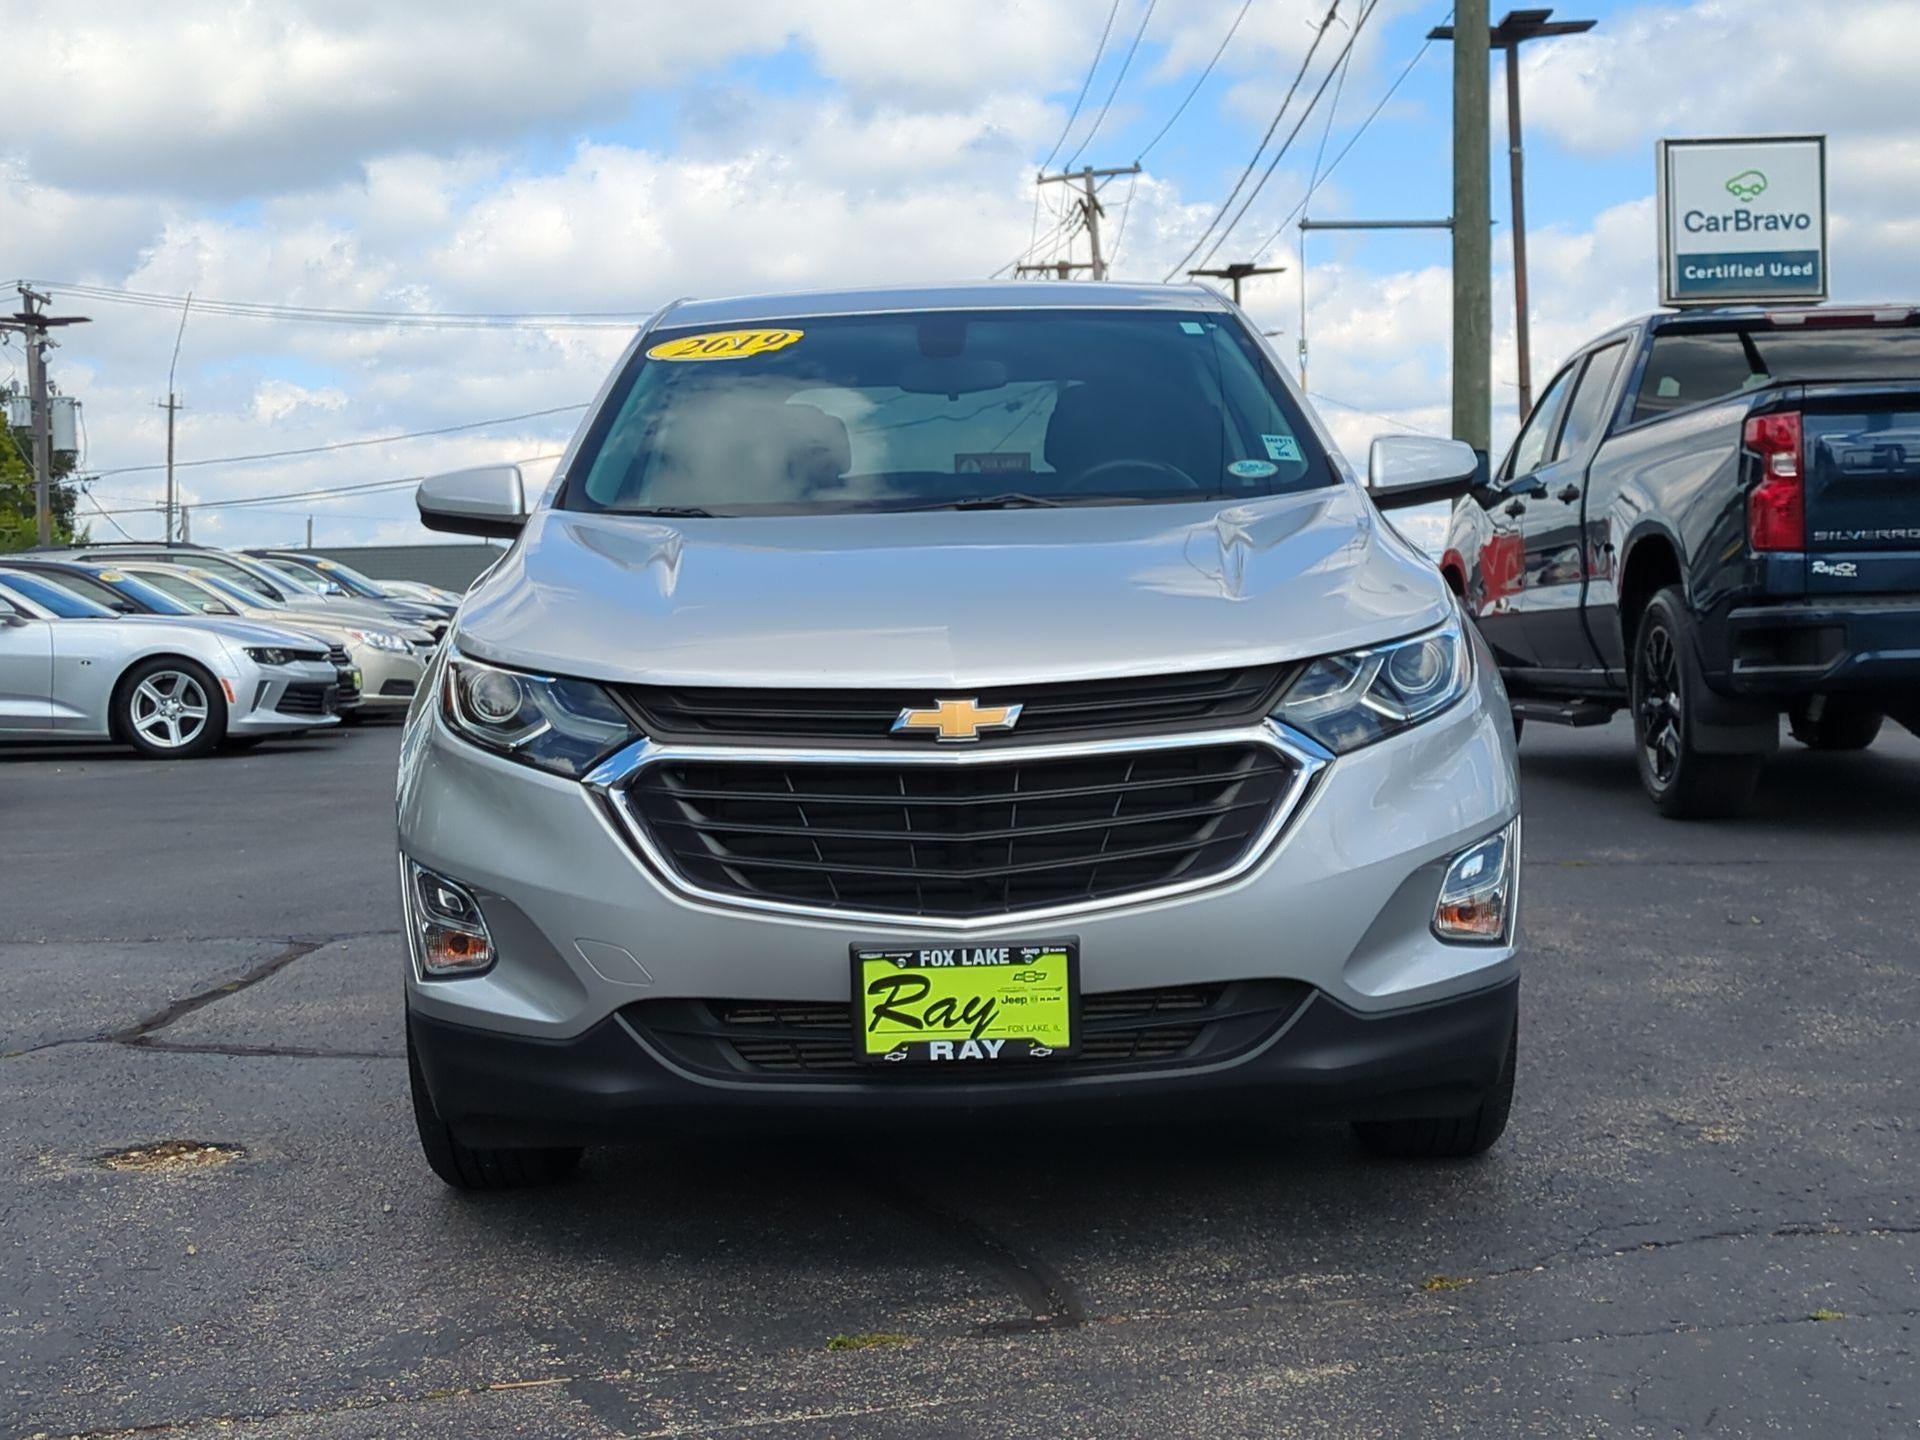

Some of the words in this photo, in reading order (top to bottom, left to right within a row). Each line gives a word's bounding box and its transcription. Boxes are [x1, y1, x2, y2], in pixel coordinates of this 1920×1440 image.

[1684, 209, 1811, 233] CarBravo
[1684, 263, 1765, 279] Certified
[1769, 261, 1813, 277] Used
[671, 332, 790, 356] 2019
[920, 949, 955, 967] FOX
[962, 948, 1010, 966] LAKE
[1021, 947, 1040, 955] Jeep
[867, 973, 999, 1039] Ray
[1001, 995, 1028, 1005] Jeep
[1007, 1025, 1025, 1033] FOX
[929, 1039, 1006, 1061] RAY
